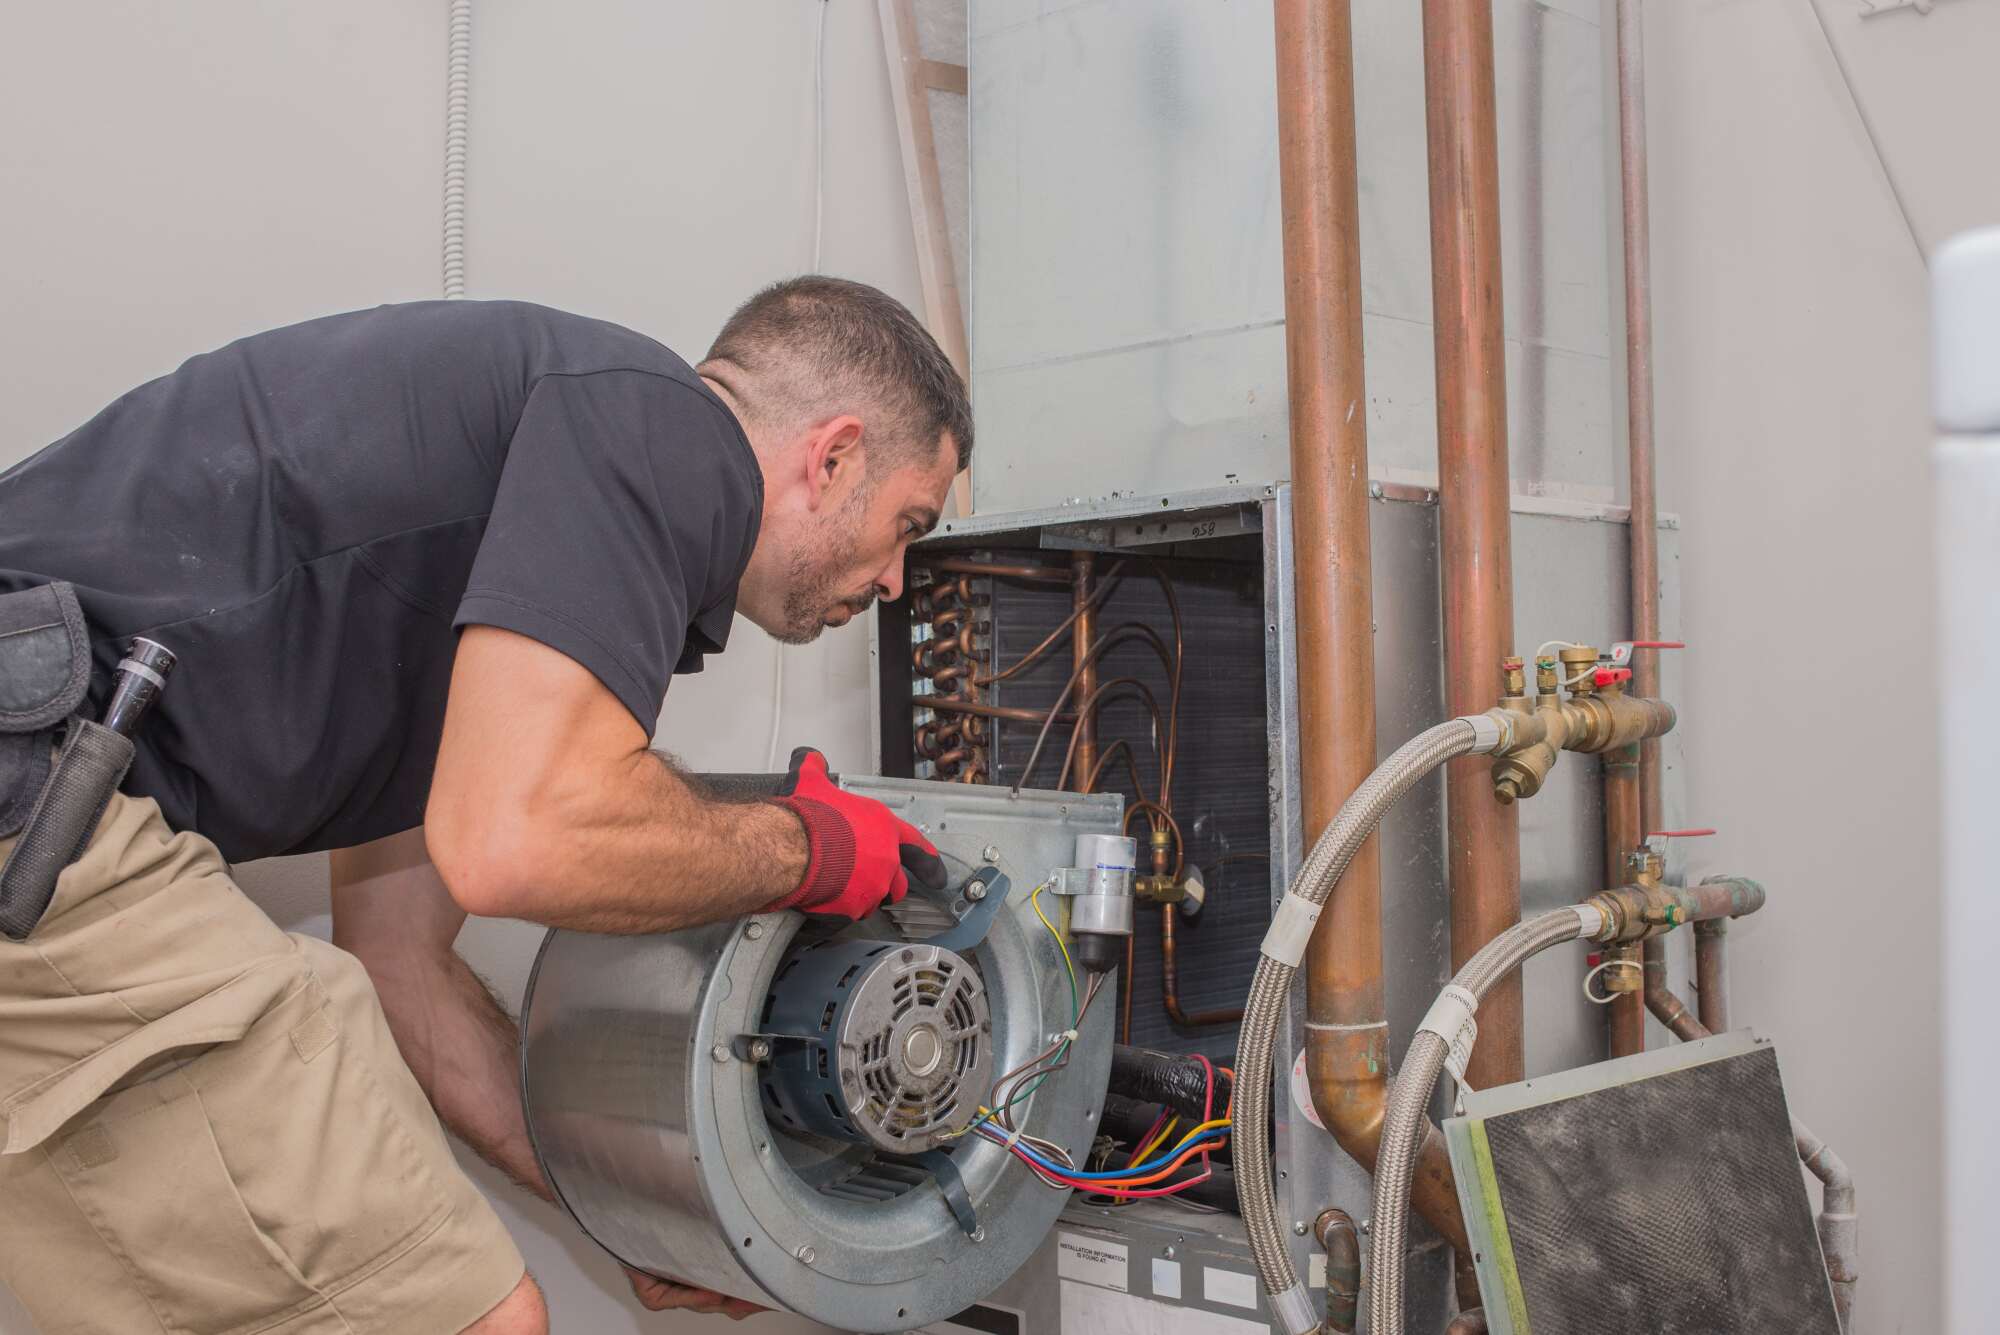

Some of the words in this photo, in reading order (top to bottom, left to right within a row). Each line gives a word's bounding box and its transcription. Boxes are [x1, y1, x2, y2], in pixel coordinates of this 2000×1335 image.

[1060, 1242, 1092, 1255] INSTALLATION
[1093, 1250, 1126, 1263] INFORMATION
[1082, 1253, 1098, 1262] FOUND
